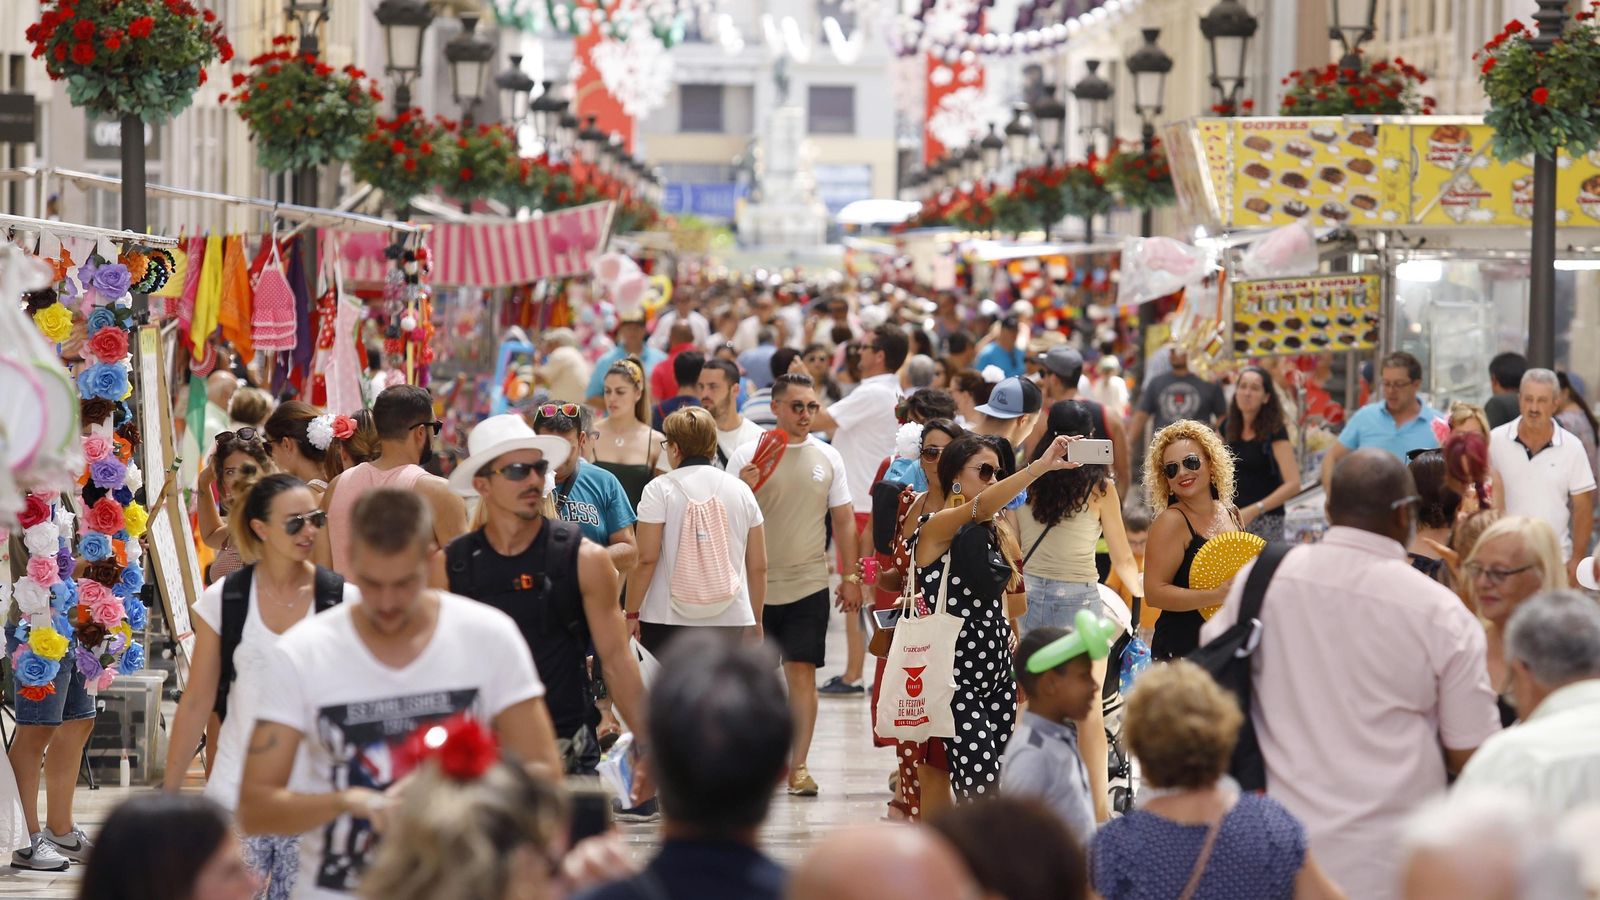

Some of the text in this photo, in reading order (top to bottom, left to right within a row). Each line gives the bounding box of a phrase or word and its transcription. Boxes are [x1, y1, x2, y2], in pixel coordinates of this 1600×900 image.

[1242, 120, 1309, 130] GOFRES
[559, 501, 598, 526] LESS
[898, 708, 905, 716] DE
